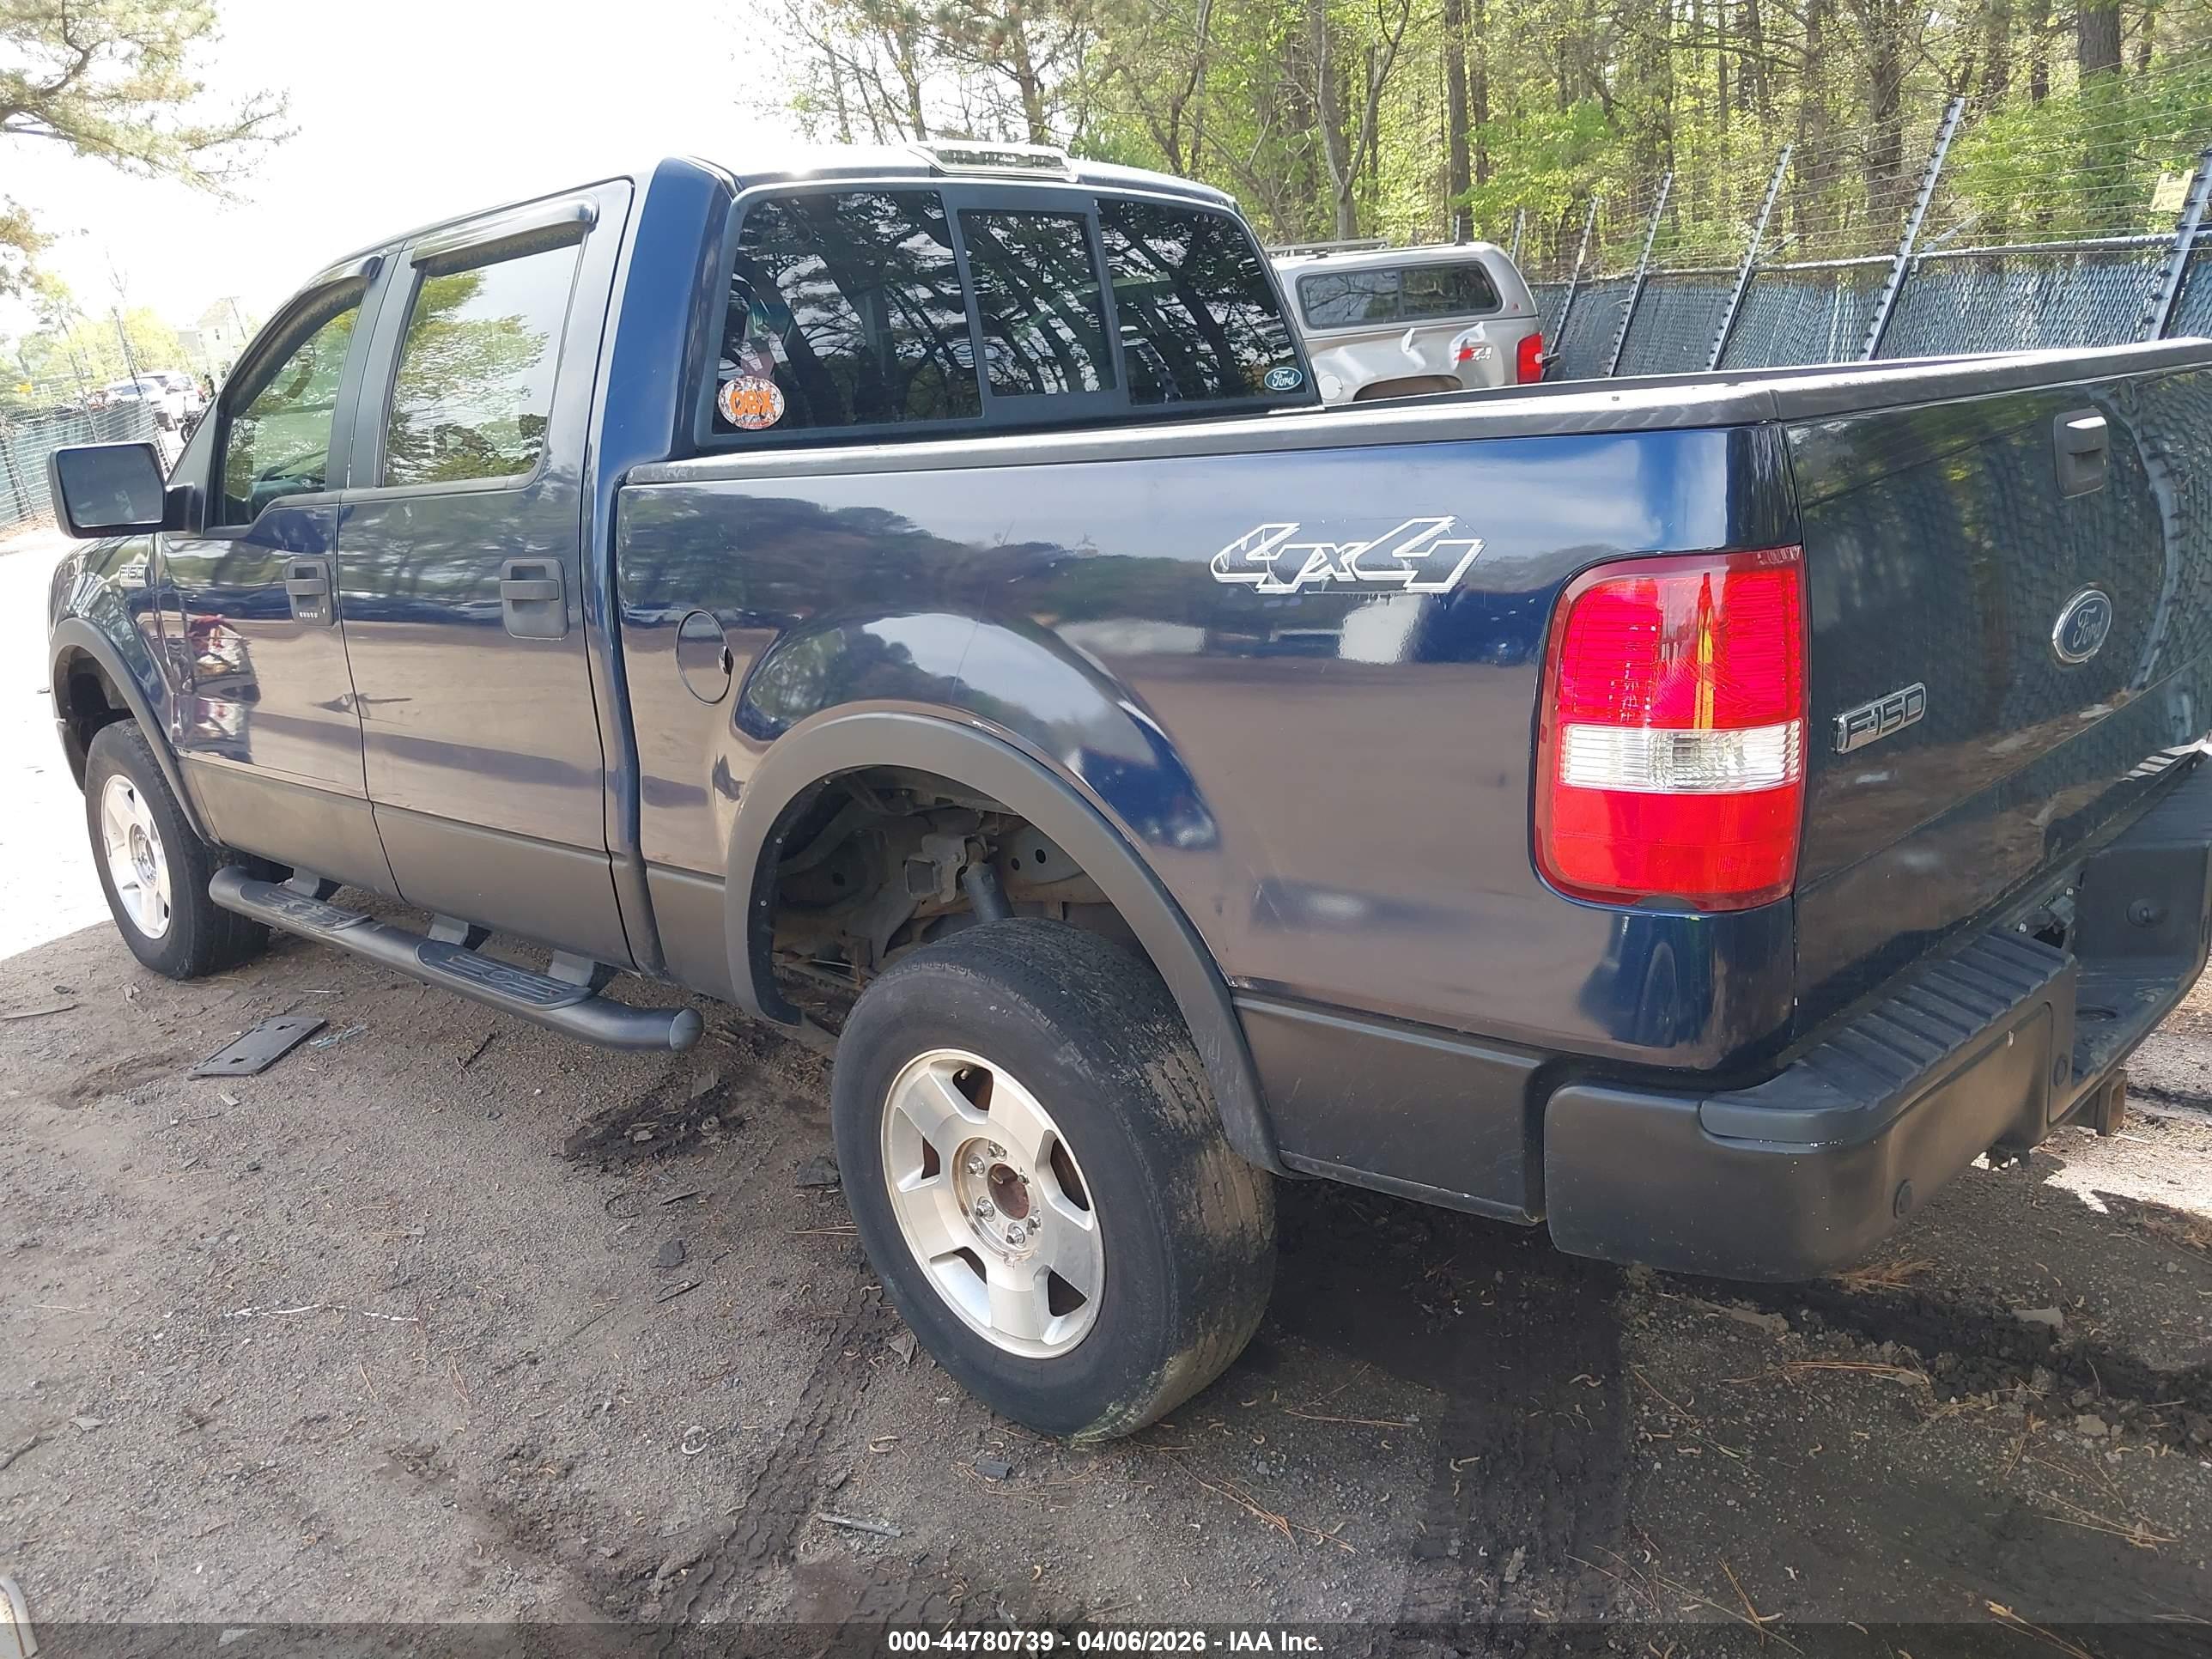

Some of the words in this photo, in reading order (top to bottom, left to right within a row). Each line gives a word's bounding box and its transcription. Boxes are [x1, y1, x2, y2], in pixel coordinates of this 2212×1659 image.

[1272, 370, 1296, 387] Ford
[730, 390, 775, 416] OBX
[2072, 605, 2104, 648] Ford
